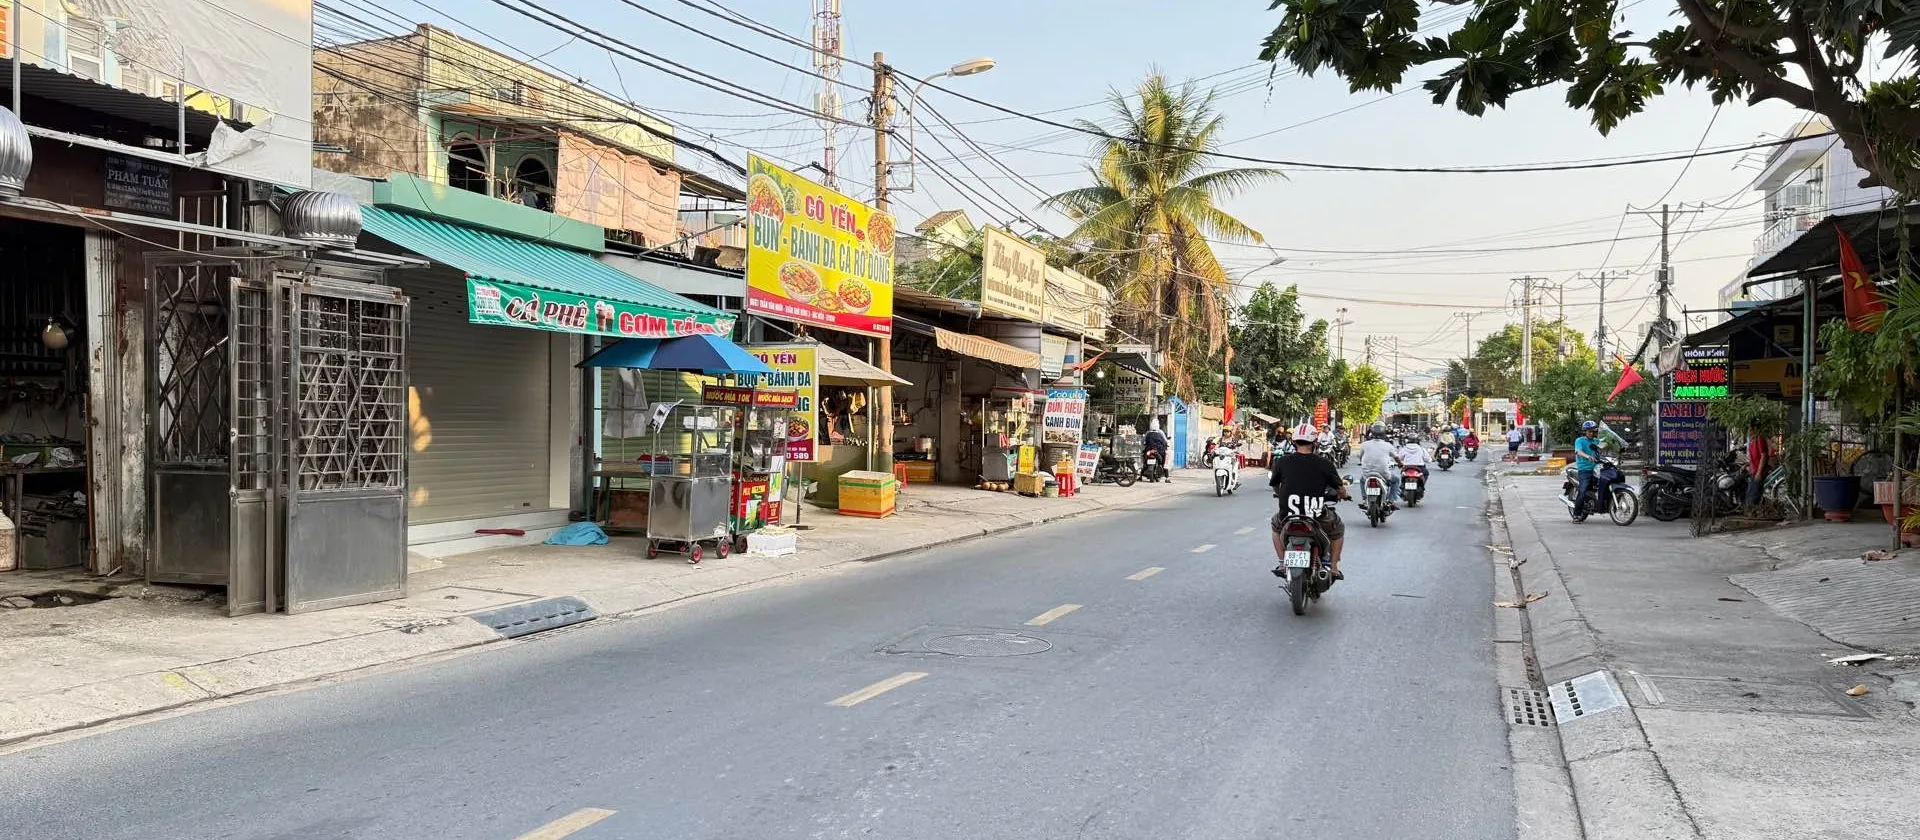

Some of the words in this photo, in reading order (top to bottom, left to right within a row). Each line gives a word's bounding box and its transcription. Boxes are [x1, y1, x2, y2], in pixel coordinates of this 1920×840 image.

[805, 195, 825, 222] CÔ
[830, 204, 856, 233] YẾN
[754, 209, 779, 252] BÚN
[791, 223, 820, 265] BÁNH
[822, 237, 836, 269] ĐA
[840, 240, 851, 274] CÁ
[505, 292, 539, 323] CÀ
[543, 300, 589, 329] PHÊ
[620, 312, 668, 337] CƠM
[773, 351, 797, 364] YẾN
[768, 369, 794, 386] BÁNH
[798, 371, 811, 386] ĐA
[1700, 366, 1725, 383] NƯỚC
[1675, 386, 1699, 397] ANH
[1047, 400, 1062, 413] BÚN
[1661, 403, 1692, 418] ANH
[1045, 416, 1064, 428] CANH
[1065, 415, 1080, 428] BÚN
[1660, 450, 1675, 458] PHỤ
[1678, 449, 1694, 458] KIỆN
